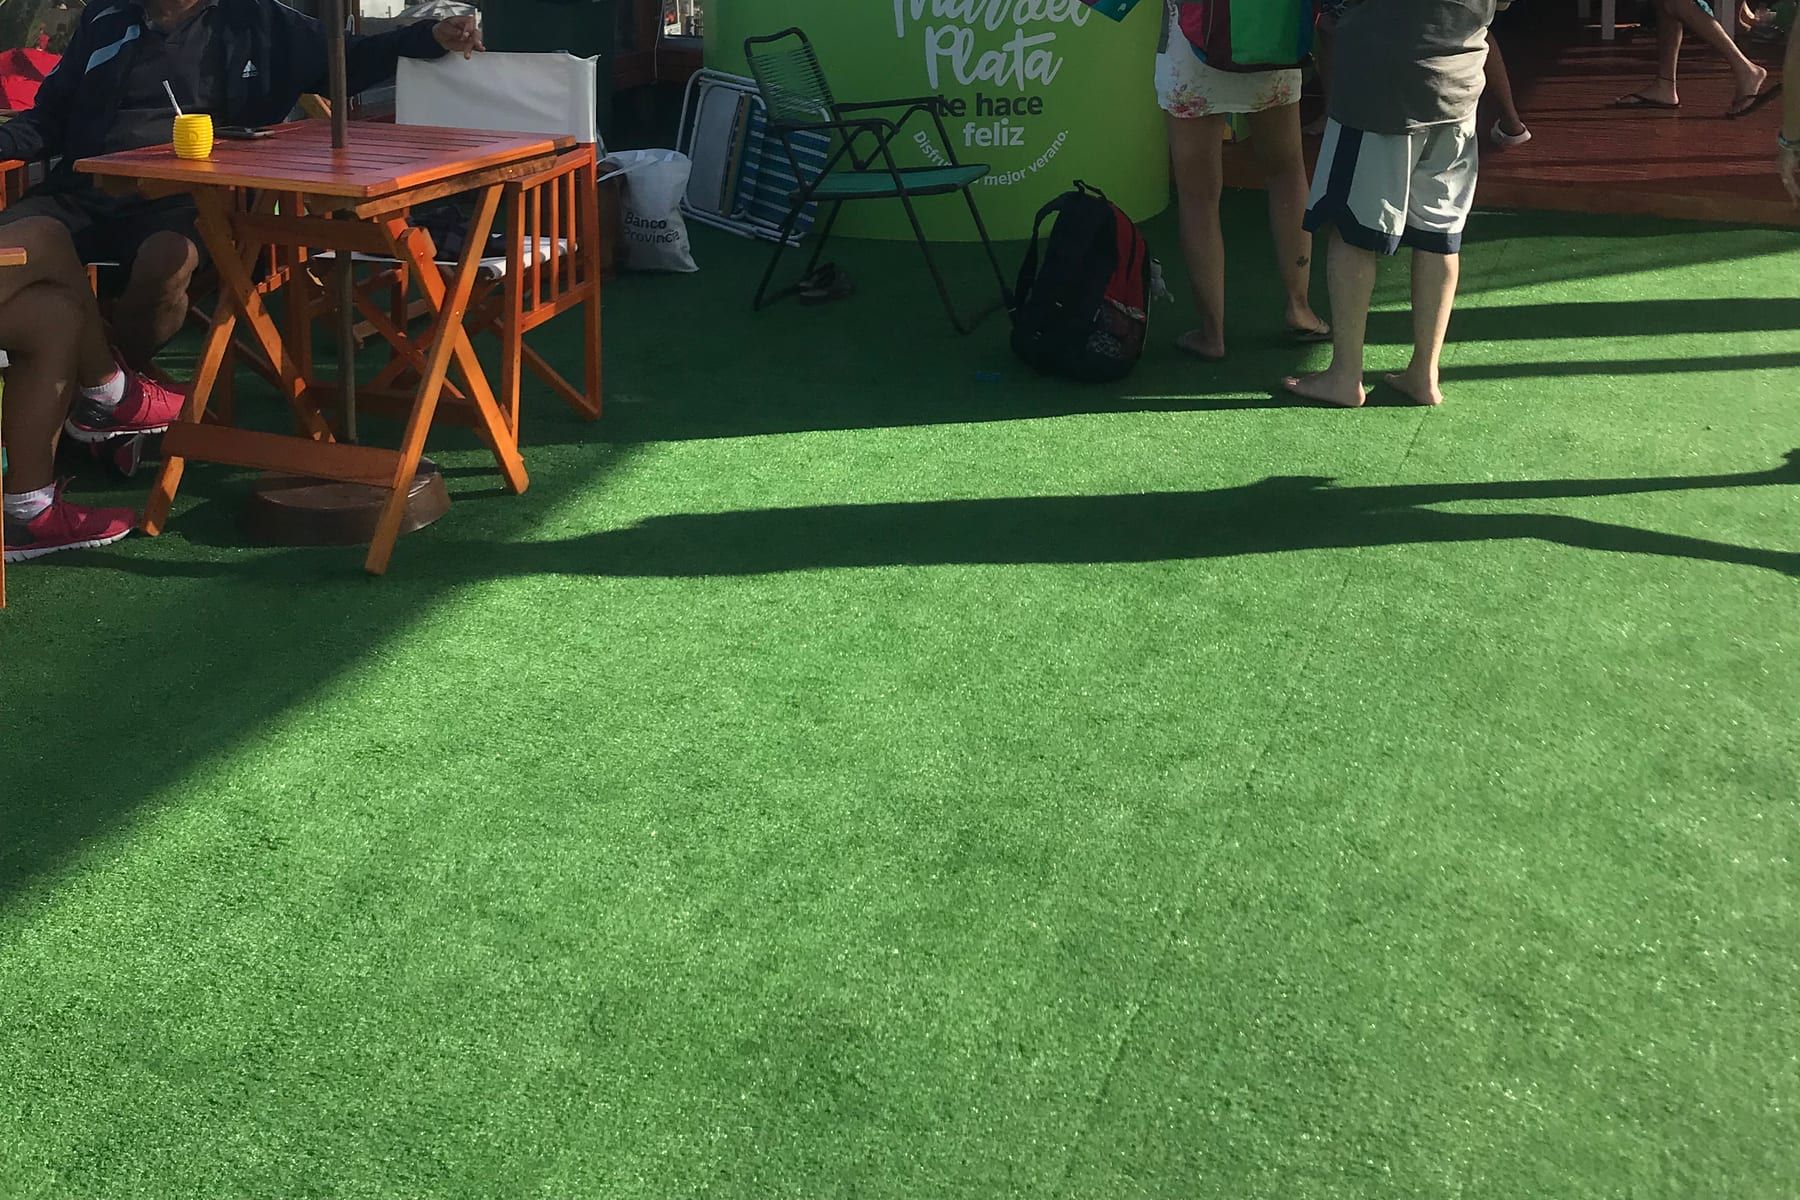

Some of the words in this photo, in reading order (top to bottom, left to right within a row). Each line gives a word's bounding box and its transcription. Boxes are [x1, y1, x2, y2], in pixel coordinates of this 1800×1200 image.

[925, 25, 1064, 92] Plata
[976, 92, 1044, 118] hace
[962, 117, 1026, 148] feliz
[984, 167, 1027, 187] mejor
[1028, 128, 1070, 174] verano.
[624, 211, 668, 230] Banco
